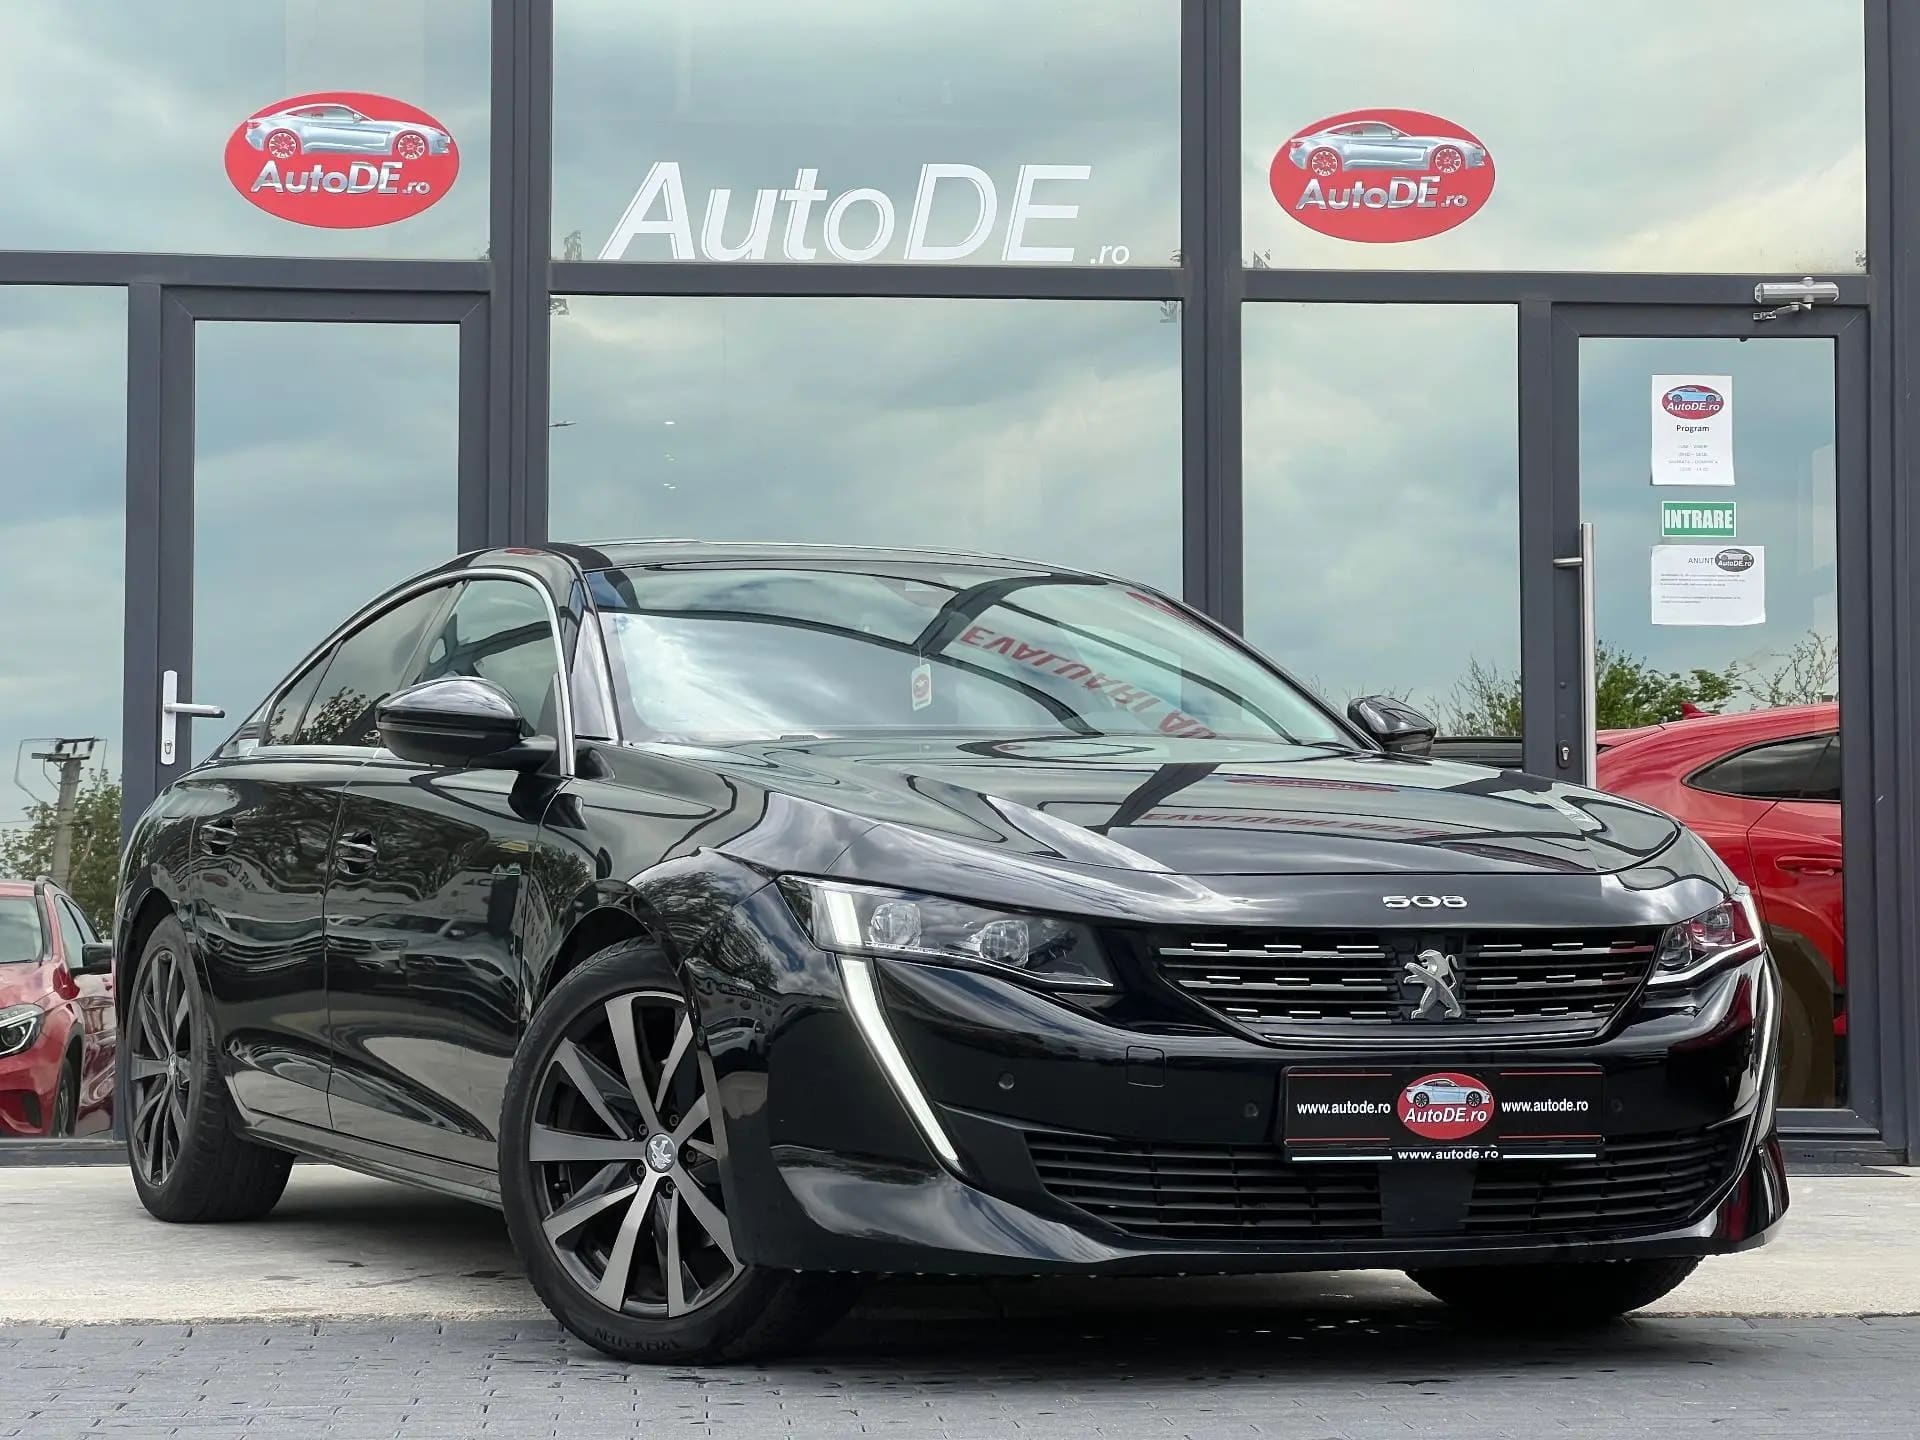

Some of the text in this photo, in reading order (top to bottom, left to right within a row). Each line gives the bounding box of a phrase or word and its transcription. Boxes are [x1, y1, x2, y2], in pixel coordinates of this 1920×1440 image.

[1667, 402, 1720, 411] AutoDE.ro
[1676, 424, 1710, 433] Program
[1664, 509, 1734, 529] INTRARE
[1382, 895, 1468, 908] 508
[1297, 1101, 1391, 1114] www.autode.ro
[1501, 1099, 1589, 1113] www.autode.ro
[1404, 1107, 1487, 1123] AutoDE.ro
[1398, 1149, 1499, 1160] www.autode.ro
